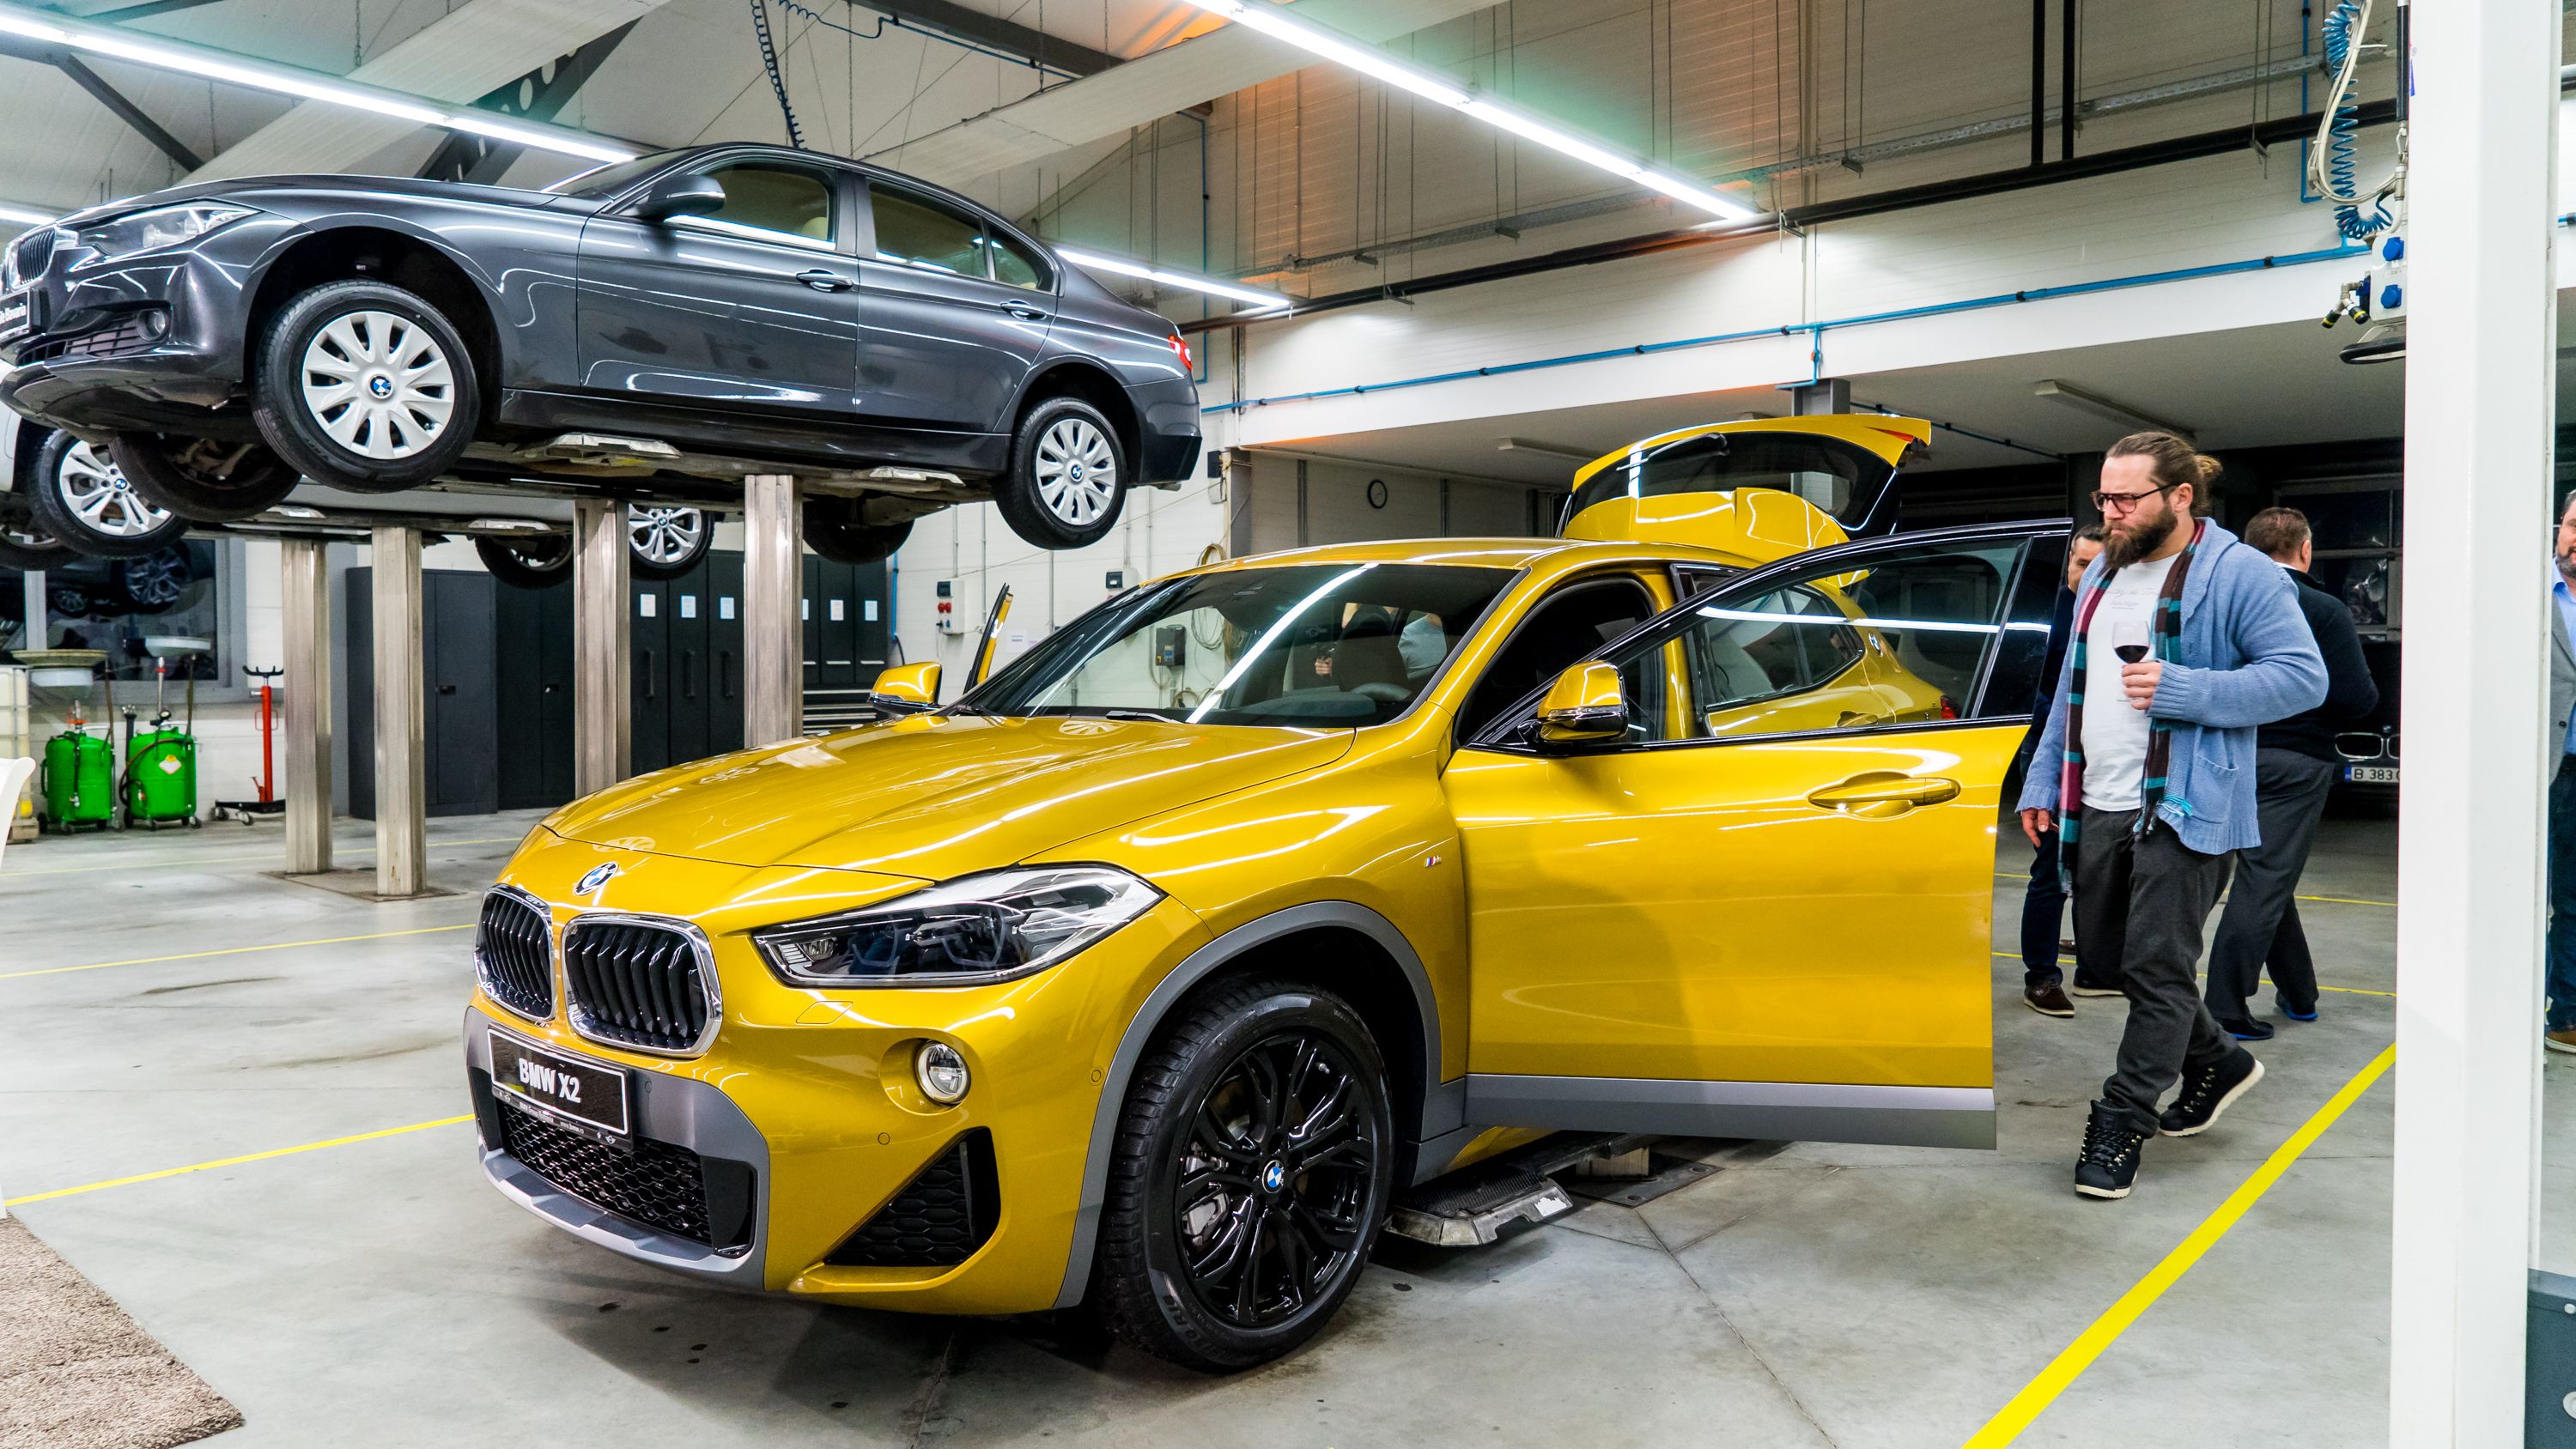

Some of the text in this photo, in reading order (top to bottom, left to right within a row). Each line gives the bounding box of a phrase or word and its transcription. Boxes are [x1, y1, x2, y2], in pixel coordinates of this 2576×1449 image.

[2354, 768, 2364, 779] B
[2369, 769, 2393, 780] 383
[519, 1058, 581, 1104] BMW X2
